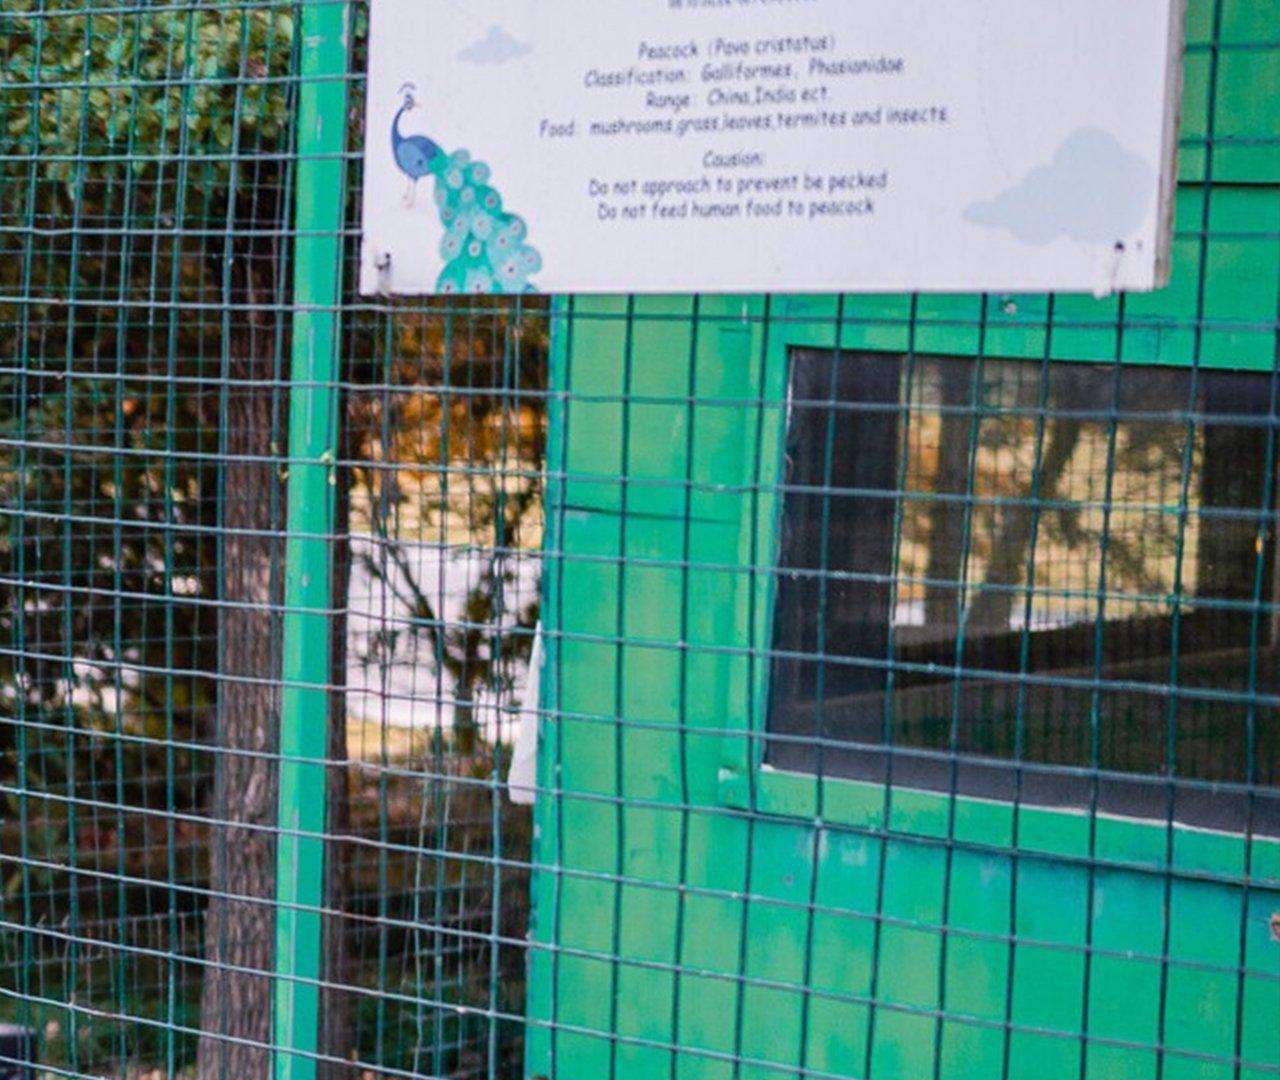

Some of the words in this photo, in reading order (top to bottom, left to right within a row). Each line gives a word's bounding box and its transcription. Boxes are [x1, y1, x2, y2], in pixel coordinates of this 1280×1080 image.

[638, 40, 698, 60] Peacock
[852, 106, 882, 125] and
[887, 104, 948, 124] insects
[589, 178, 608, 197] Do
[613, 179, 637, 195] not
[642, 175, 711, 196] approach
[716, 176, 732, 191] to
[737, 174, 798, 196] prevent
[803, 172, 824, 190] be
[828, 168, 888, 193] pecked
[597, 201, 617, 221] Do
[622, 203, 646, 218] not
[652, 199, 688, 219] feed
[692, 198, 740, 218] human
[746, 197, 782, 218] food
[788, 199, 804, 216] to
[808, 196, 874, 220] peacock
